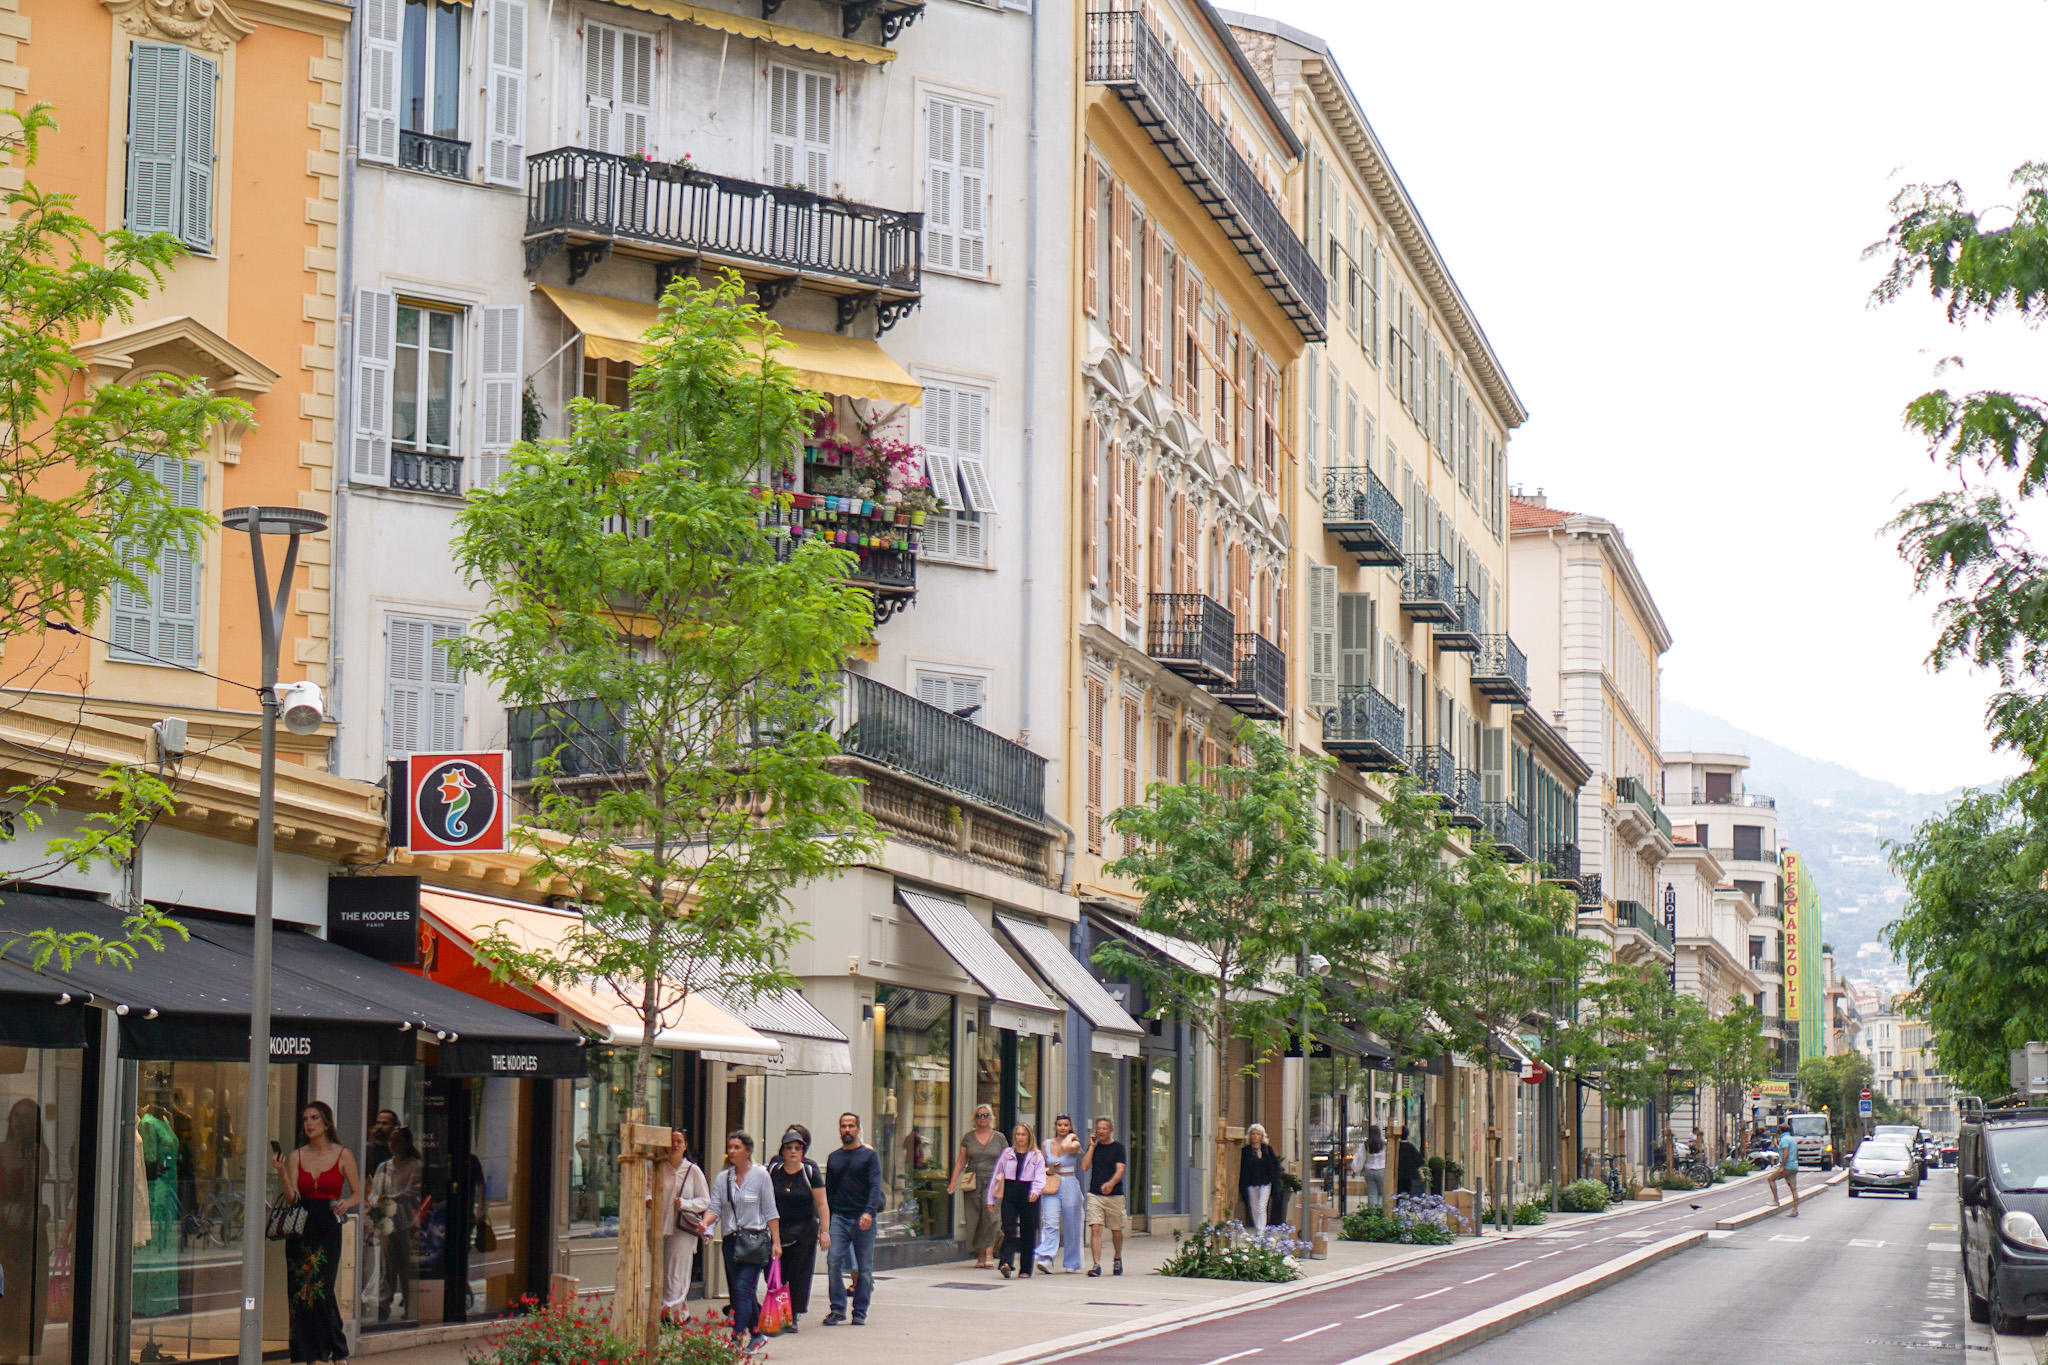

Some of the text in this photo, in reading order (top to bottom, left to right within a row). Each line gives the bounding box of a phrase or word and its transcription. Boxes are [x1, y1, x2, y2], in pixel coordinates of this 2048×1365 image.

[341, 911, 410, 921] THE KOOPLES
[1665, 892, 1676, 938] HOTE
[1785, 856, 1798, 1008] PESCARZOLI
[269, 1036, 312, 1055] KOOPLES
[491, 1054, 538, 1071] THE KOOPLES
